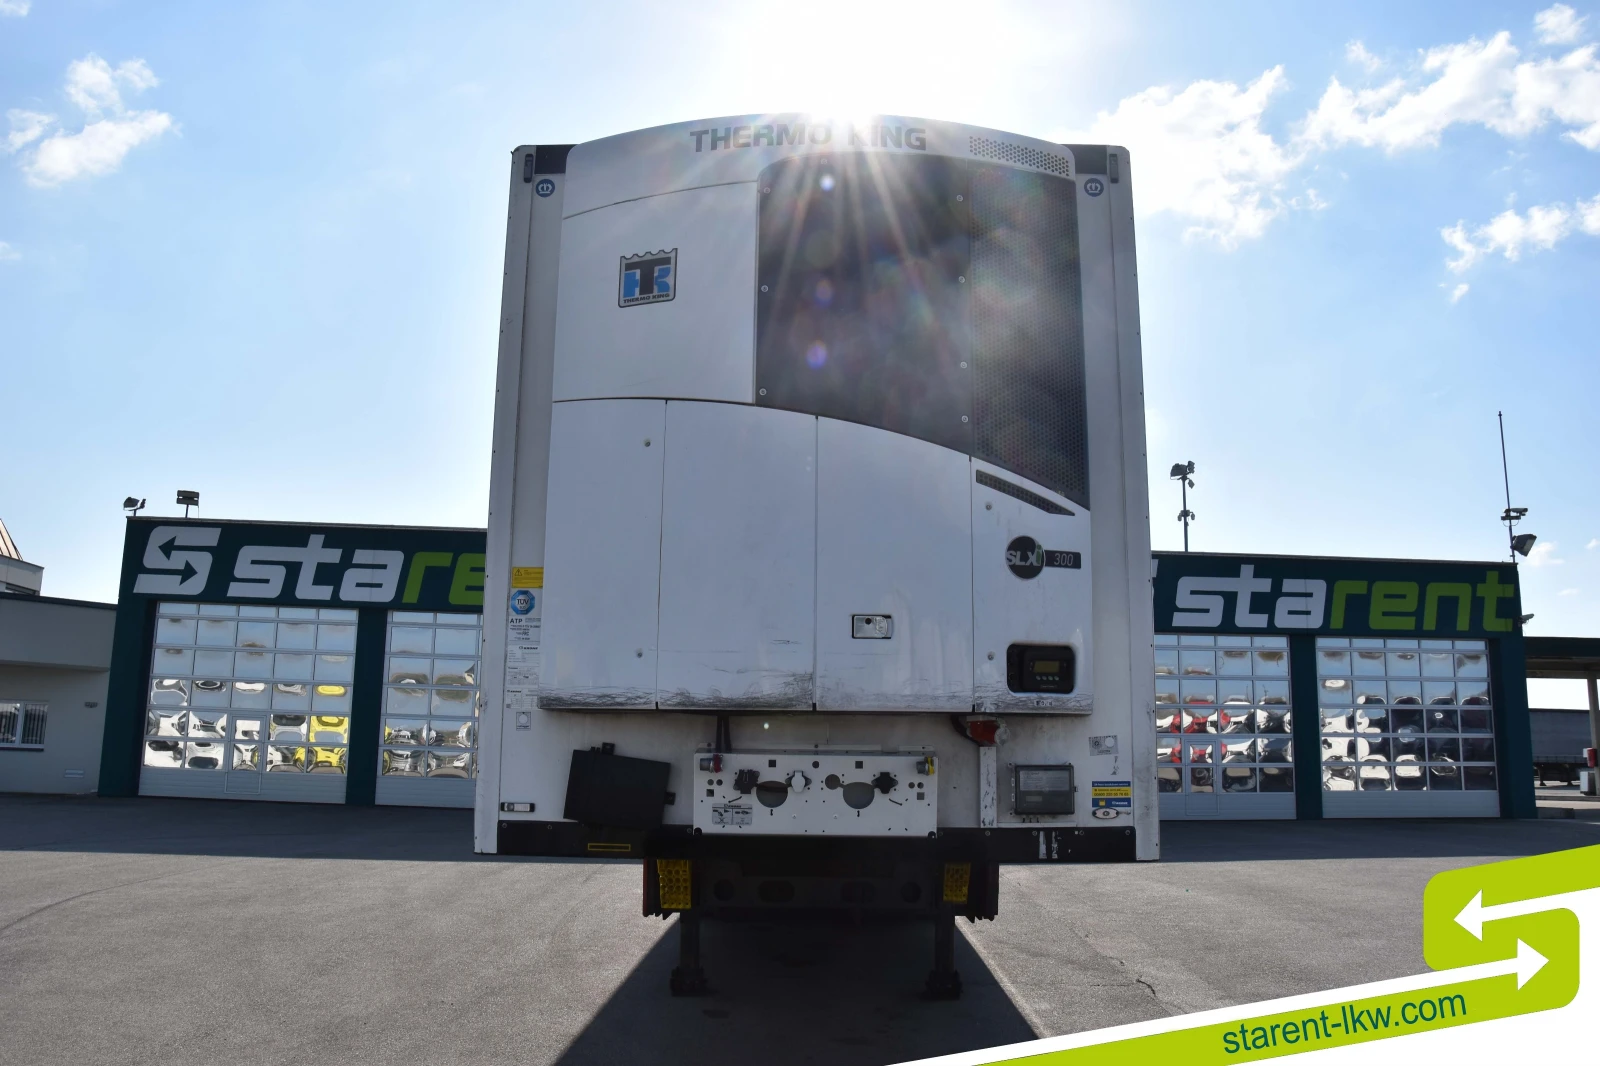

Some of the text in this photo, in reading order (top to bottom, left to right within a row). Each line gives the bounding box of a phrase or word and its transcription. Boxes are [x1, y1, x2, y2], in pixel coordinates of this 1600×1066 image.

[690, 123, 927, 152] THERMO KING
[623, 296, 651, 304] THERMO
[1053, 553, 1074, 567] 300
[1171, 564, 1515, 632] starent
